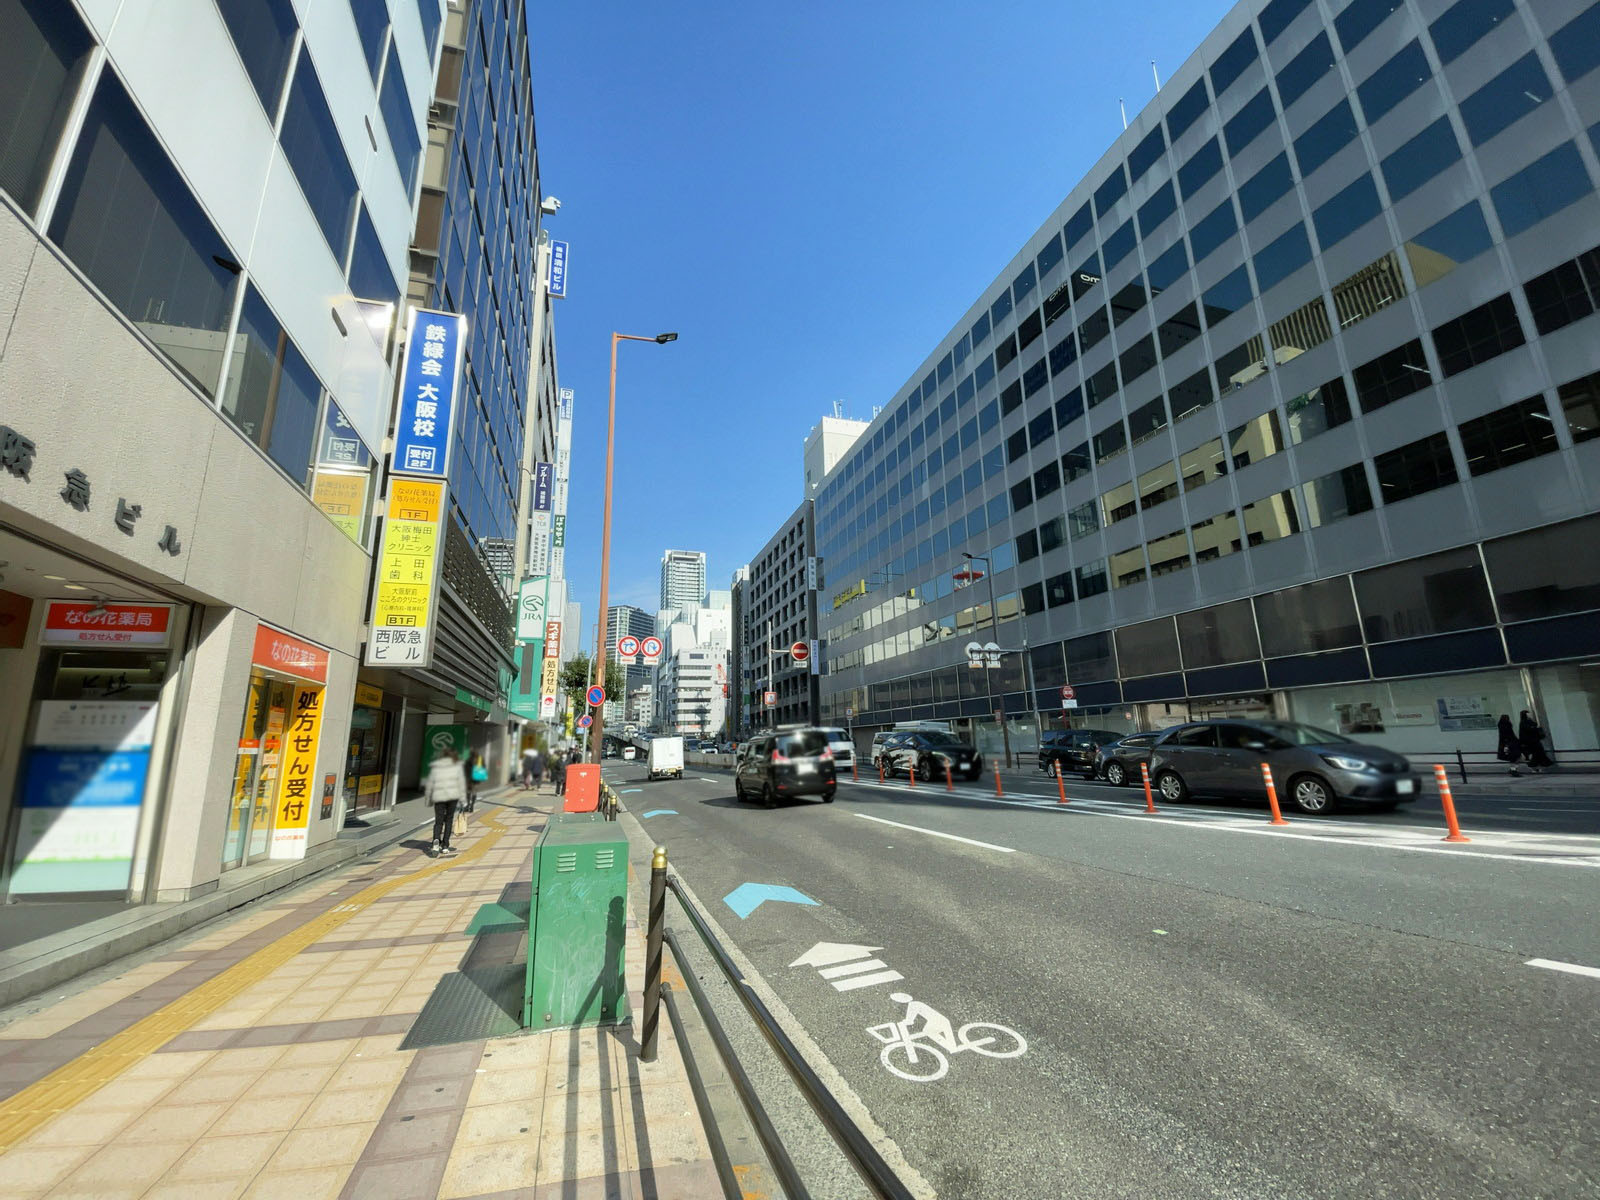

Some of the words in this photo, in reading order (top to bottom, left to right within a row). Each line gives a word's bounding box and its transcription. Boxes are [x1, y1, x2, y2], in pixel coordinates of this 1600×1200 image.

[422, 325, 446, 377] 鉄緑会
[413, 384, 439, 438] 大阪校
[409, 448, 433, 460] 受付
[391, 525, 432, 535] 大阪梅田
[388, 543, 431, 552] クリニック
[379, 595, 428, 605] こころのクリニック
[389, 616, 414, 625] B1F
[521, 613, 542, 621] JRA
[375, 629, 422, 645] 西阪急
[375, 646, 421, 660] ビル
[546, 660, 555, 693] 処方せん
[282, 691, 319, 822] 処方せん受付
